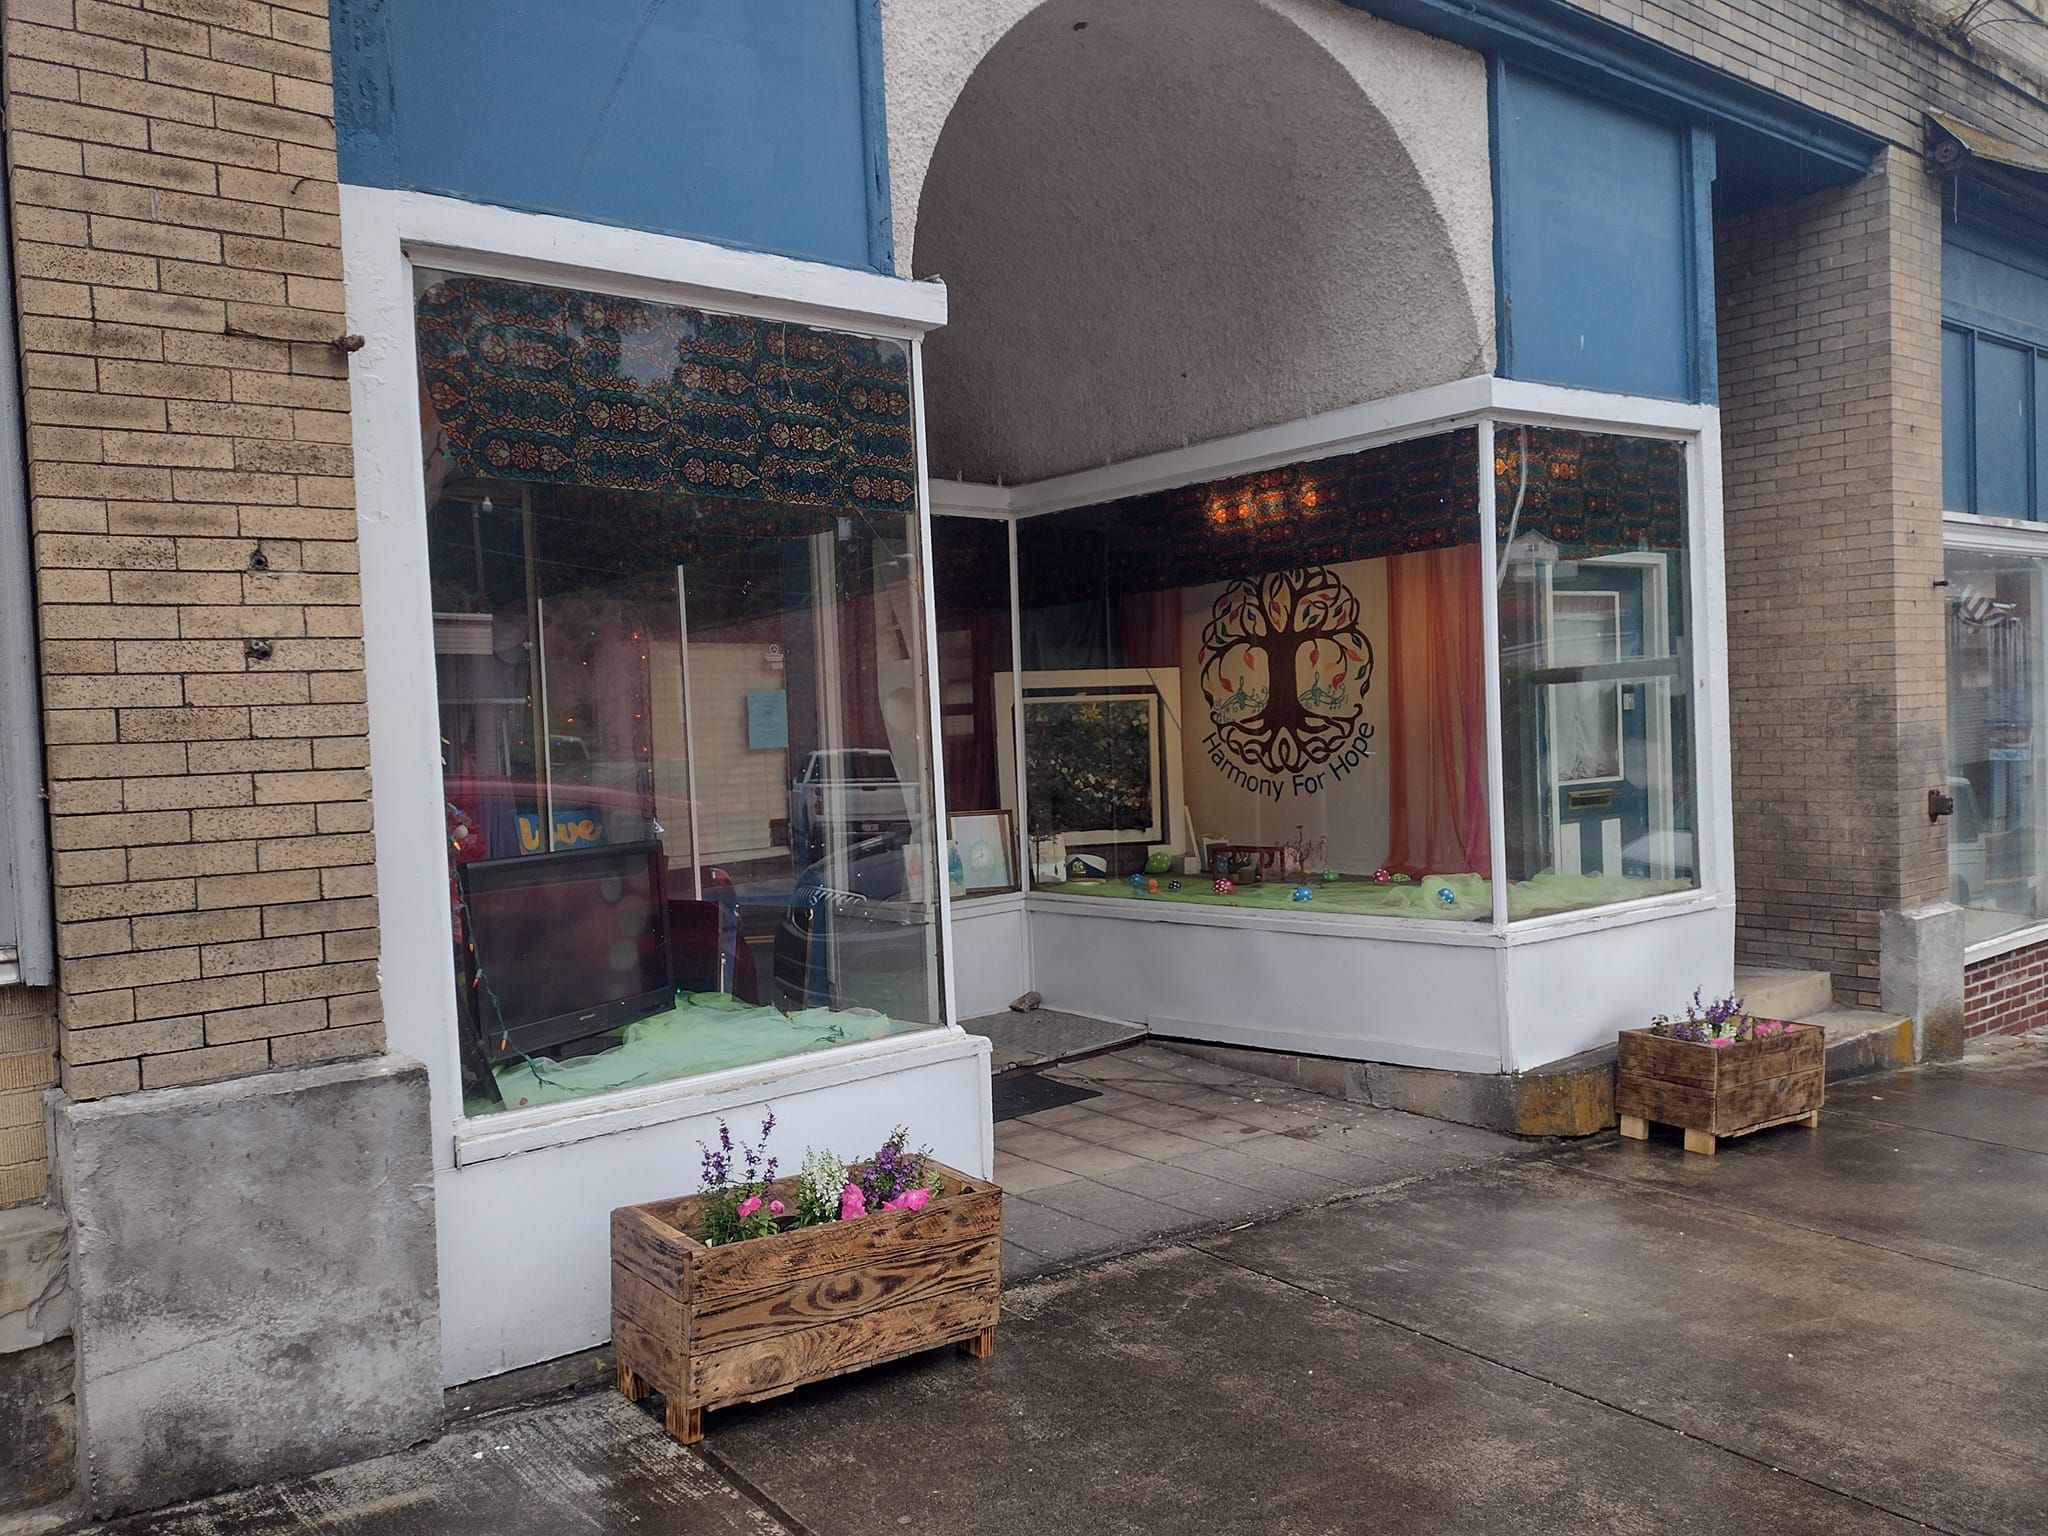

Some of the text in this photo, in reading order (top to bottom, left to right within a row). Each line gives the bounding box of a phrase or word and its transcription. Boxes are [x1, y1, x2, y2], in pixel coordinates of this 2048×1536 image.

[1202, 722, 1375, 802] Harmony For Hope
[519, 817, 602, 850] Lve
